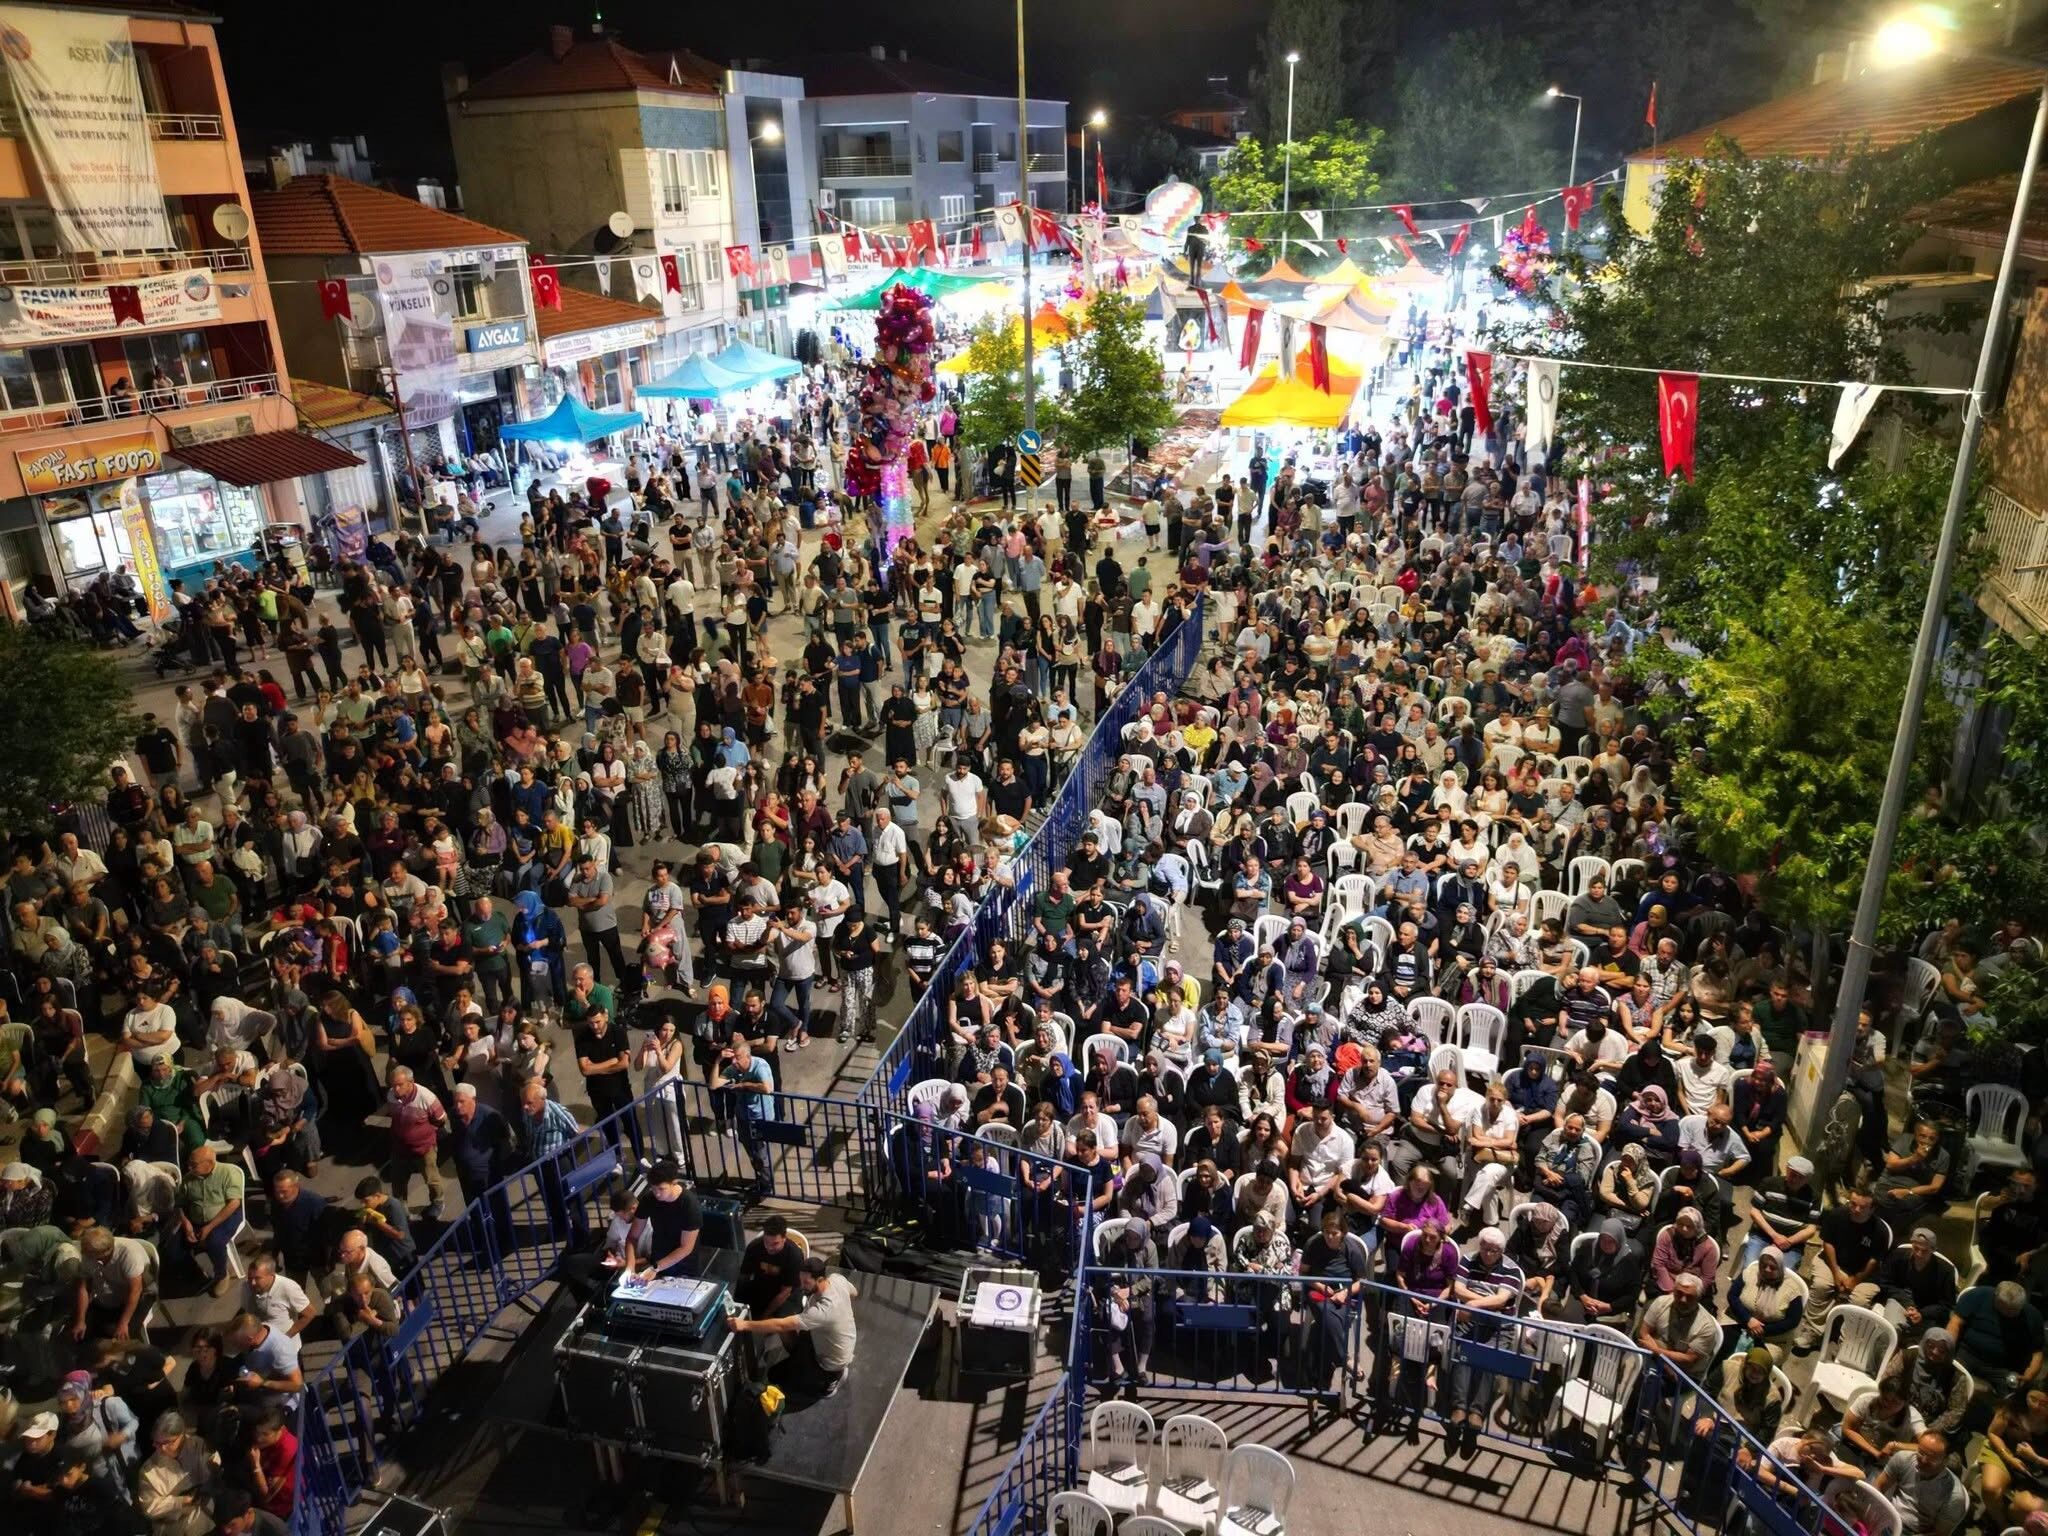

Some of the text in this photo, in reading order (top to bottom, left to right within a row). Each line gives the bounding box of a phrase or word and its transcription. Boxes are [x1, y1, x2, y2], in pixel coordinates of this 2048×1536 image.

[21, 288, 79, 305] PASVAK
[478, 326, 520, 349] AYGAZ
[51, 447, 156, 485] FAST FOOD
[134, 527, 153, 569] FAST
[146, 571, 166, 610] FOOD
